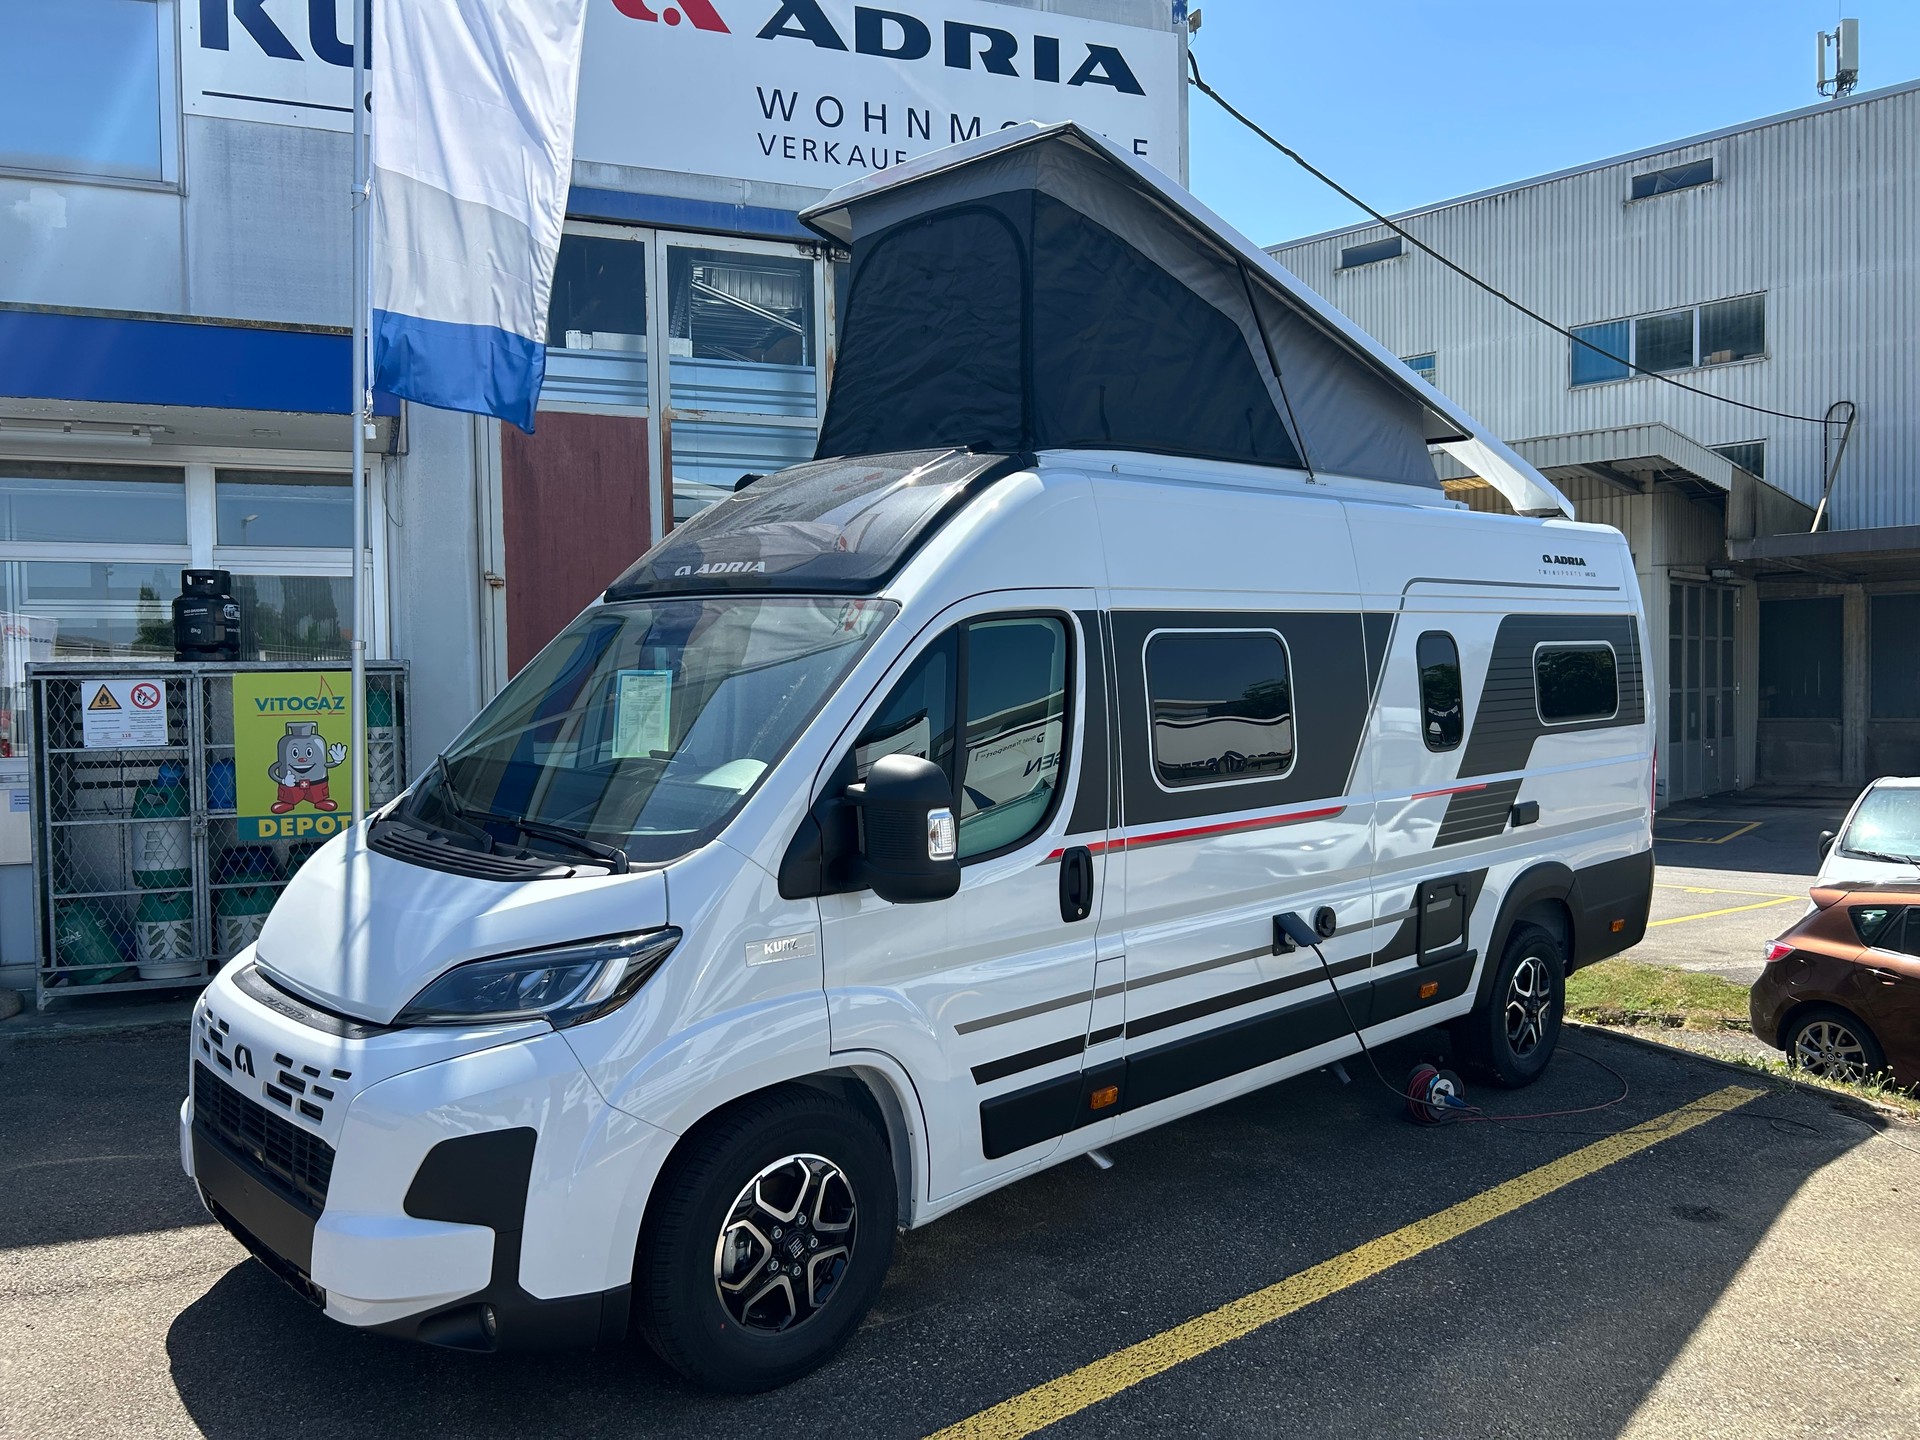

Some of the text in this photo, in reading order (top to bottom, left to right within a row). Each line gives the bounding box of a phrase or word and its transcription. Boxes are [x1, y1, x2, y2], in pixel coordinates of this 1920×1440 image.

[755, 0, 1147, 97] ADRIA
[756, 86, 1148, 156] WOHNME
[693, 561, 766, 575] ADRIA
[1554, 555, 1586, 566] ADRIA
[258, 815, 352, 838] DEPOT
